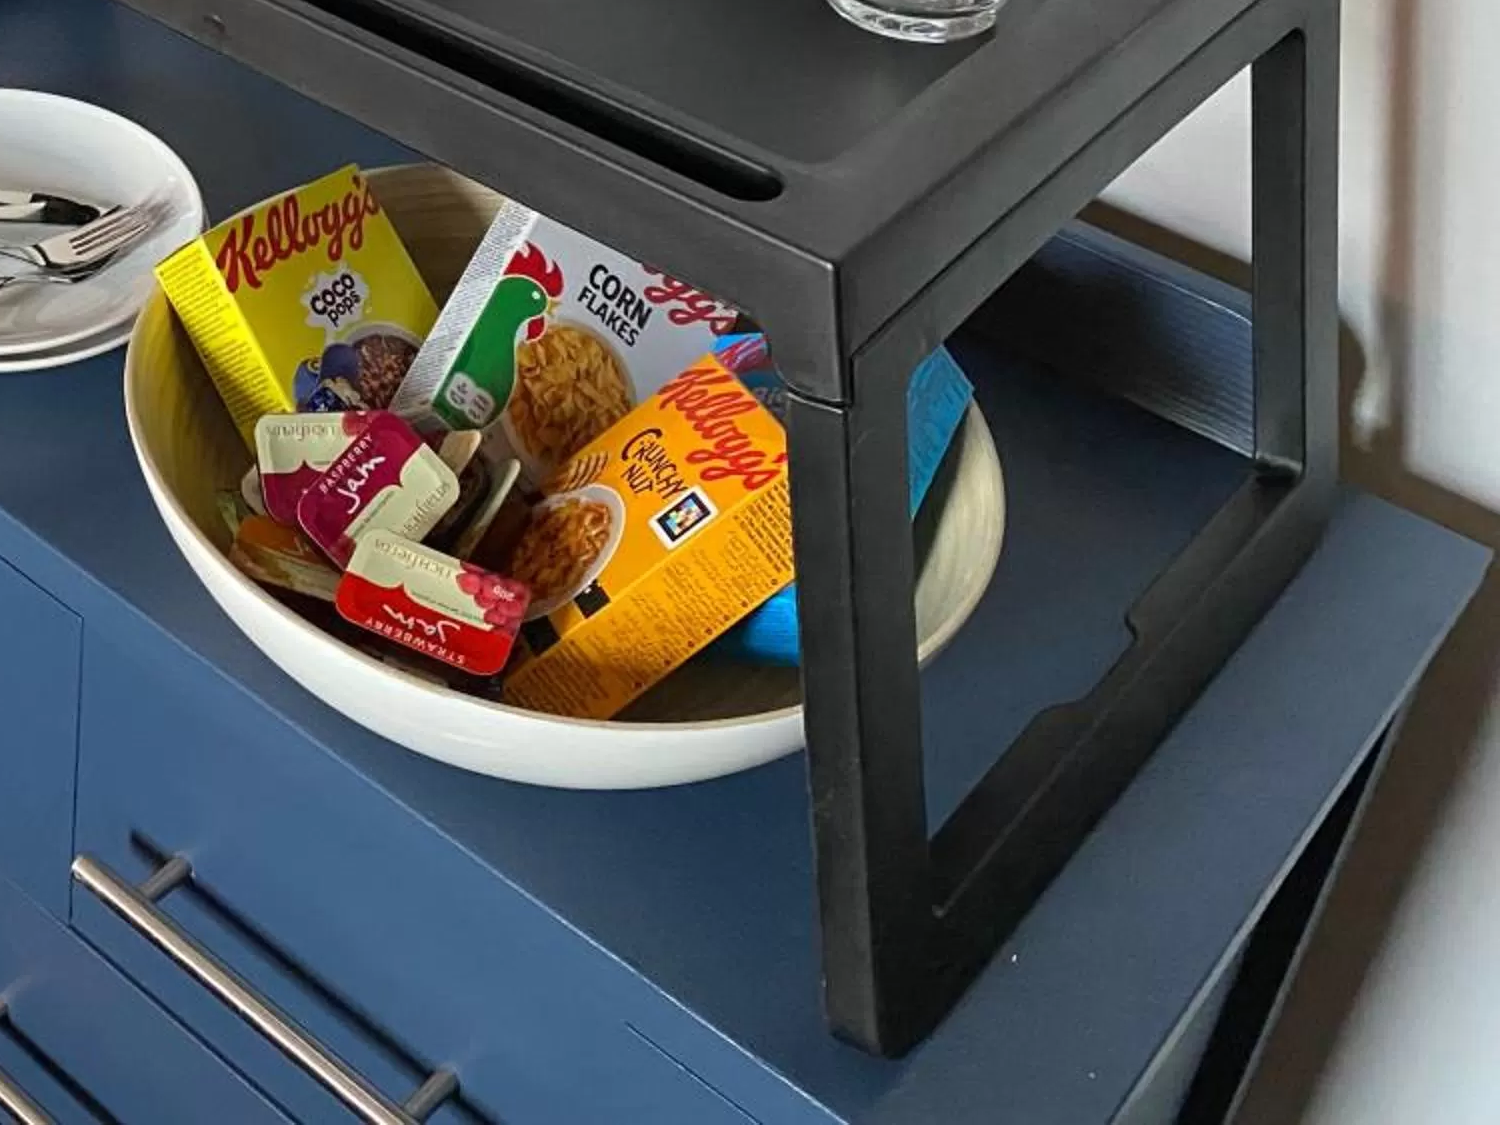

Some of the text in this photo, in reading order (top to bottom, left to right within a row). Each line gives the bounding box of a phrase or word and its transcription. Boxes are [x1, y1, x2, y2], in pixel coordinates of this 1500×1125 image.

[216, 174, 380, 294] Kellogg's
[327, 290, 361, 327] pops
[577, 285, 640, 348] FLAKES
[589, 263, 653, 329] CORN
[658, 368, 790, 491] Kellogg's
[318, 434, 373, 494] RASPBERRY
[621, 462, 654, 495] NUT
[366, 617, 466, 665] STRAWBERRY
